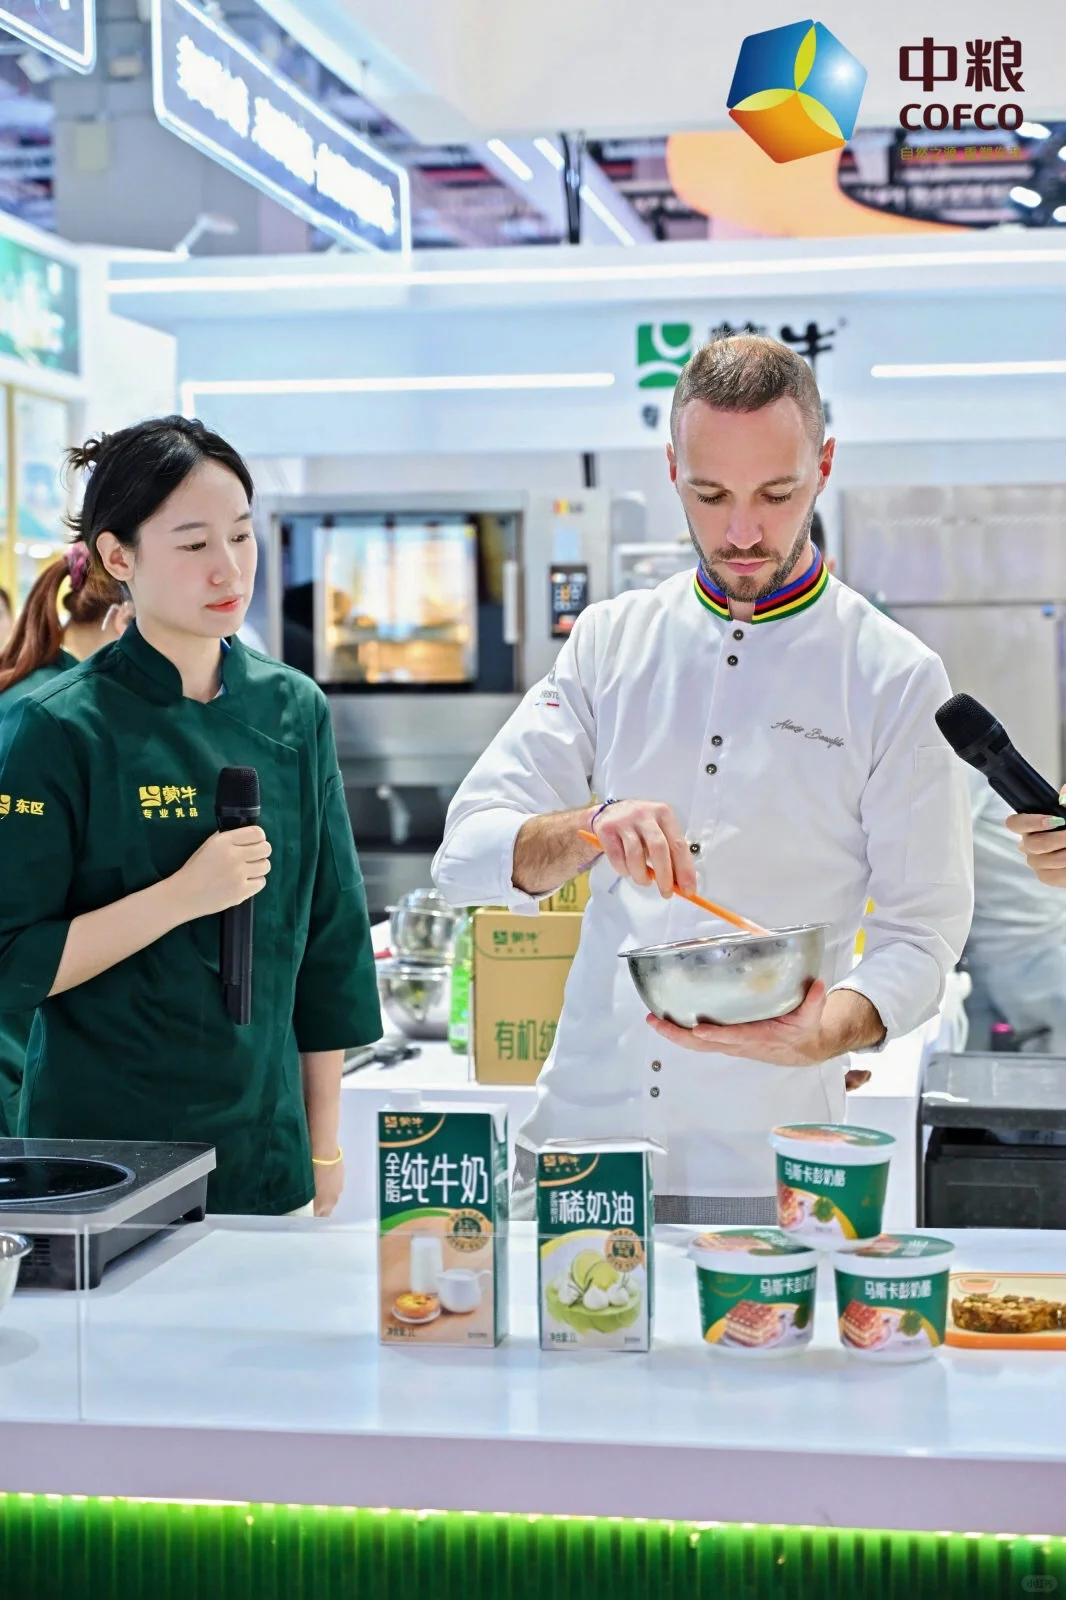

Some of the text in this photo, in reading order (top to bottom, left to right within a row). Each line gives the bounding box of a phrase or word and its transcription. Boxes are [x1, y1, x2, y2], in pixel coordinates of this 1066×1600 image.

[162, 785, 197, 805] 蒙牛
[15, 798, 45, 816] 东区
[142, 807, 199, 819] 专业乳品
[385, 1151, 489, 1205] 全脂 纯牛奶
[558, 1189, 635, 1226] 稀奶油
[864, 1279, 932, 1299] 马斯卡彭奶酪
